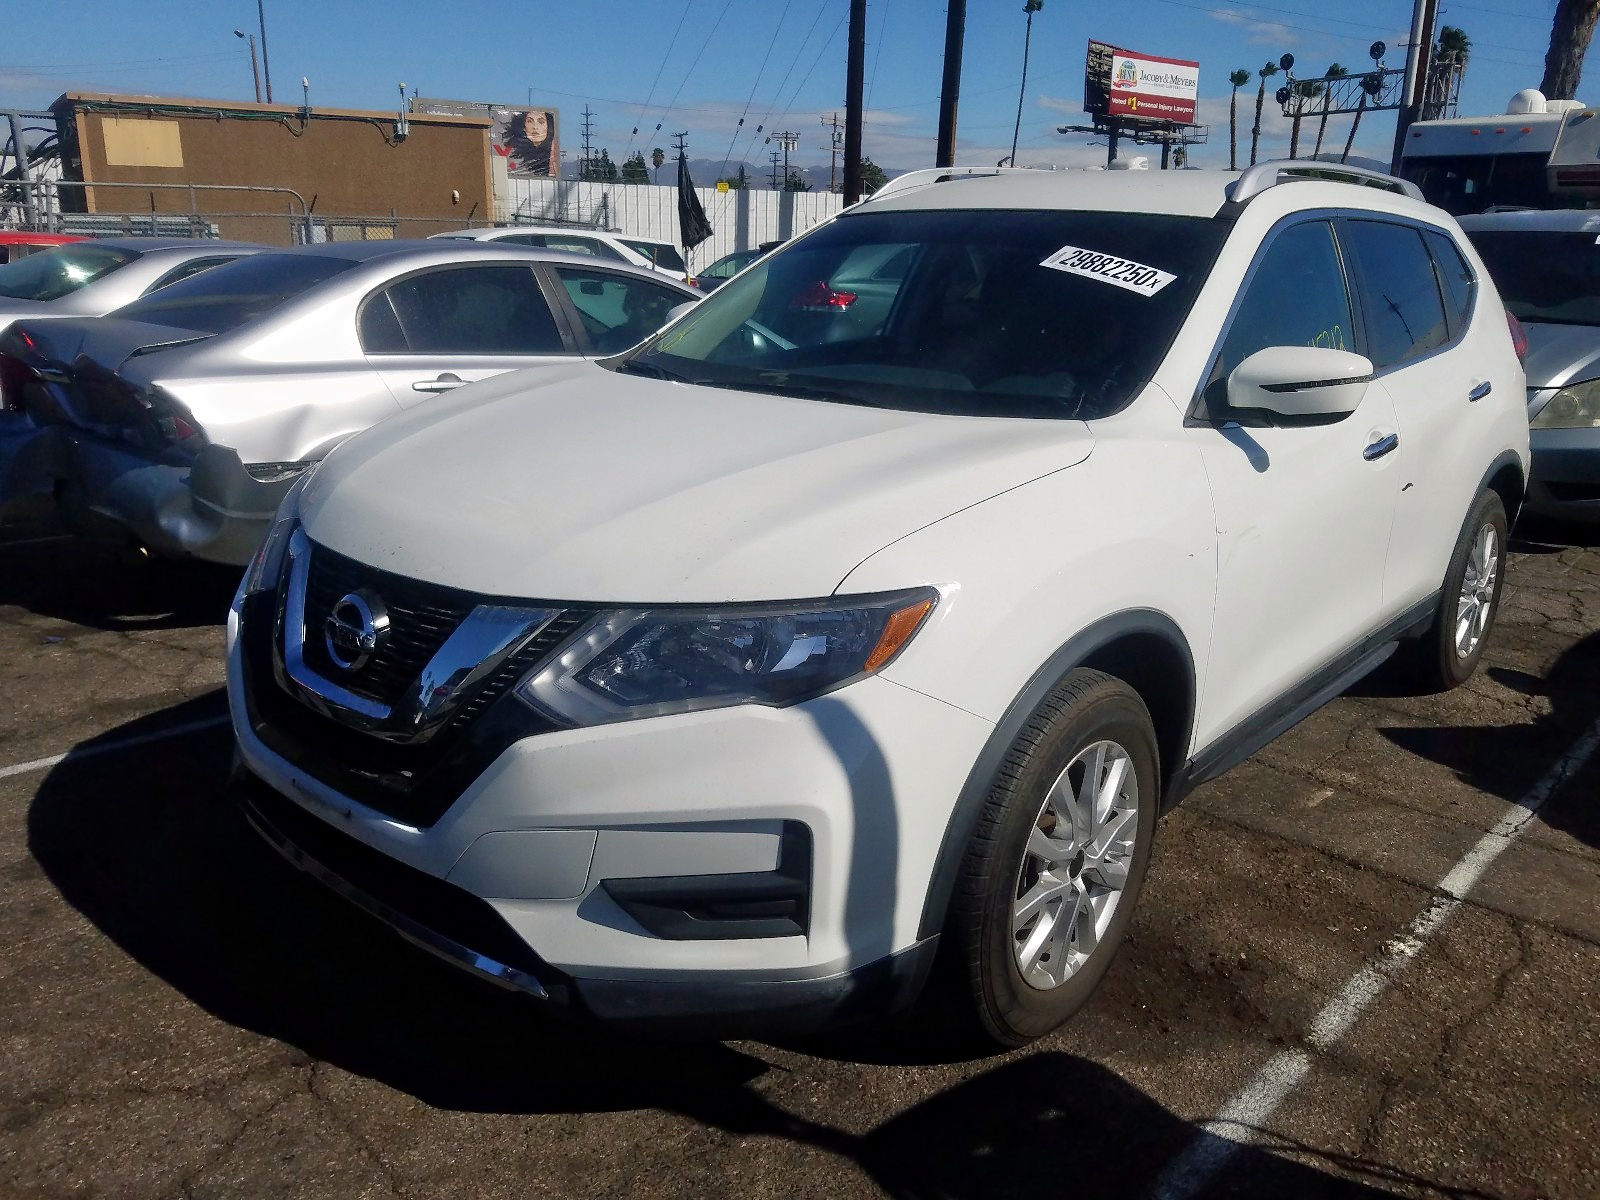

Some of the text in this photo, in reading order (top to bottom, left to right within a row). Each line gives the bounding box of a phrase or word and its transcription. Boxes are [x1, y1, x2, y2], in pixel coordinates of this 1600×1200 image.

[1140, 70, 1164, 83] JACOBY
[1170, 75, 1196, 87] MEYERS
[1112, 96, 1194, 113] Voted #1 Personal Injury Lawyers
